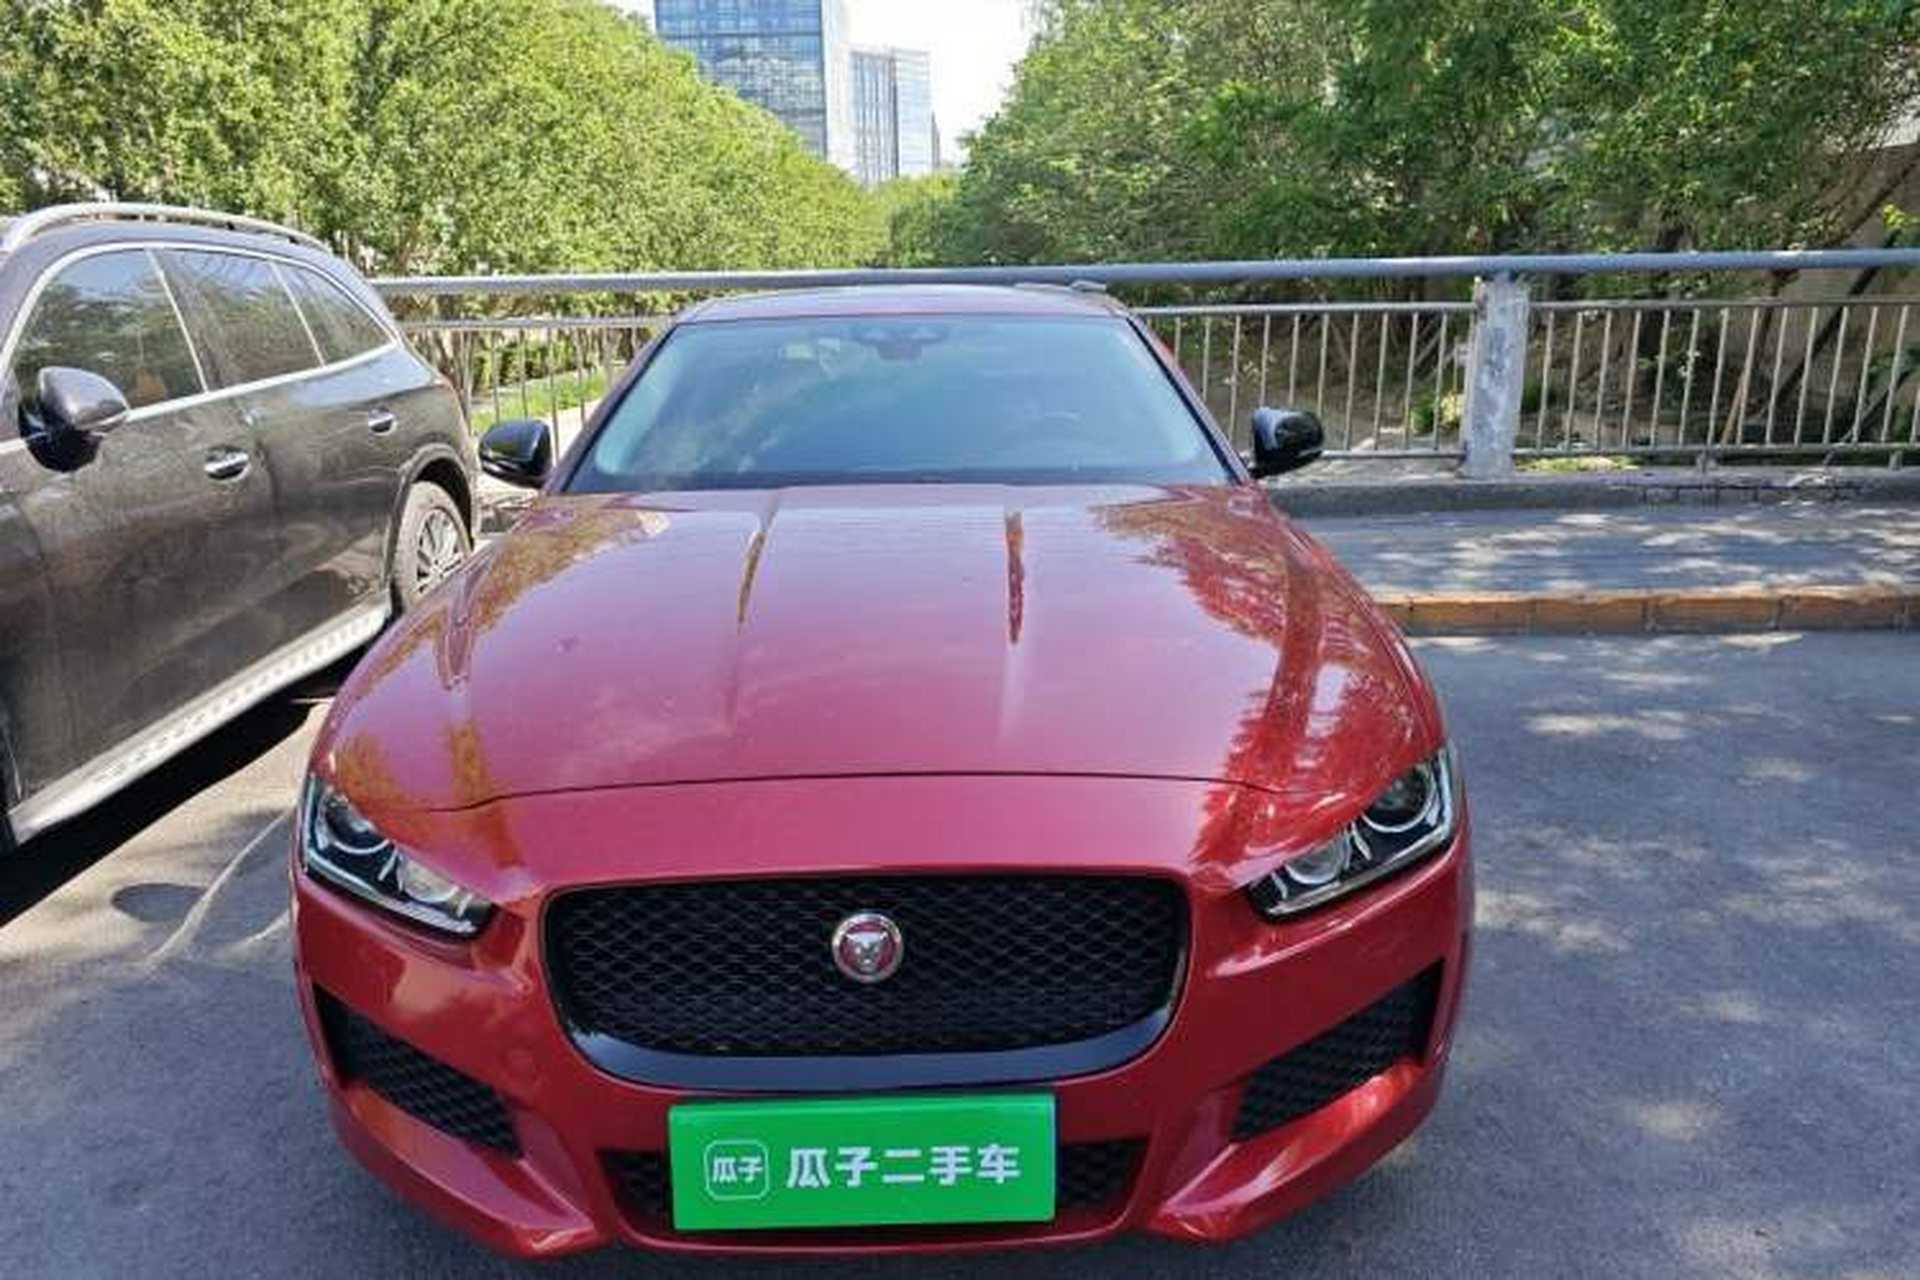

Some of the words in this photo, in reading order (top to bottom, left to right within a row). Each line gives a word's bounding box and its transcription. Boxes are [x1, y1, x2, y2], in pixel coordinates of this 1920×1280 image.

[712, 1156, 763, 1183] 瓜子
[787, 1143, 1021, 1188] 瓜子二手车
